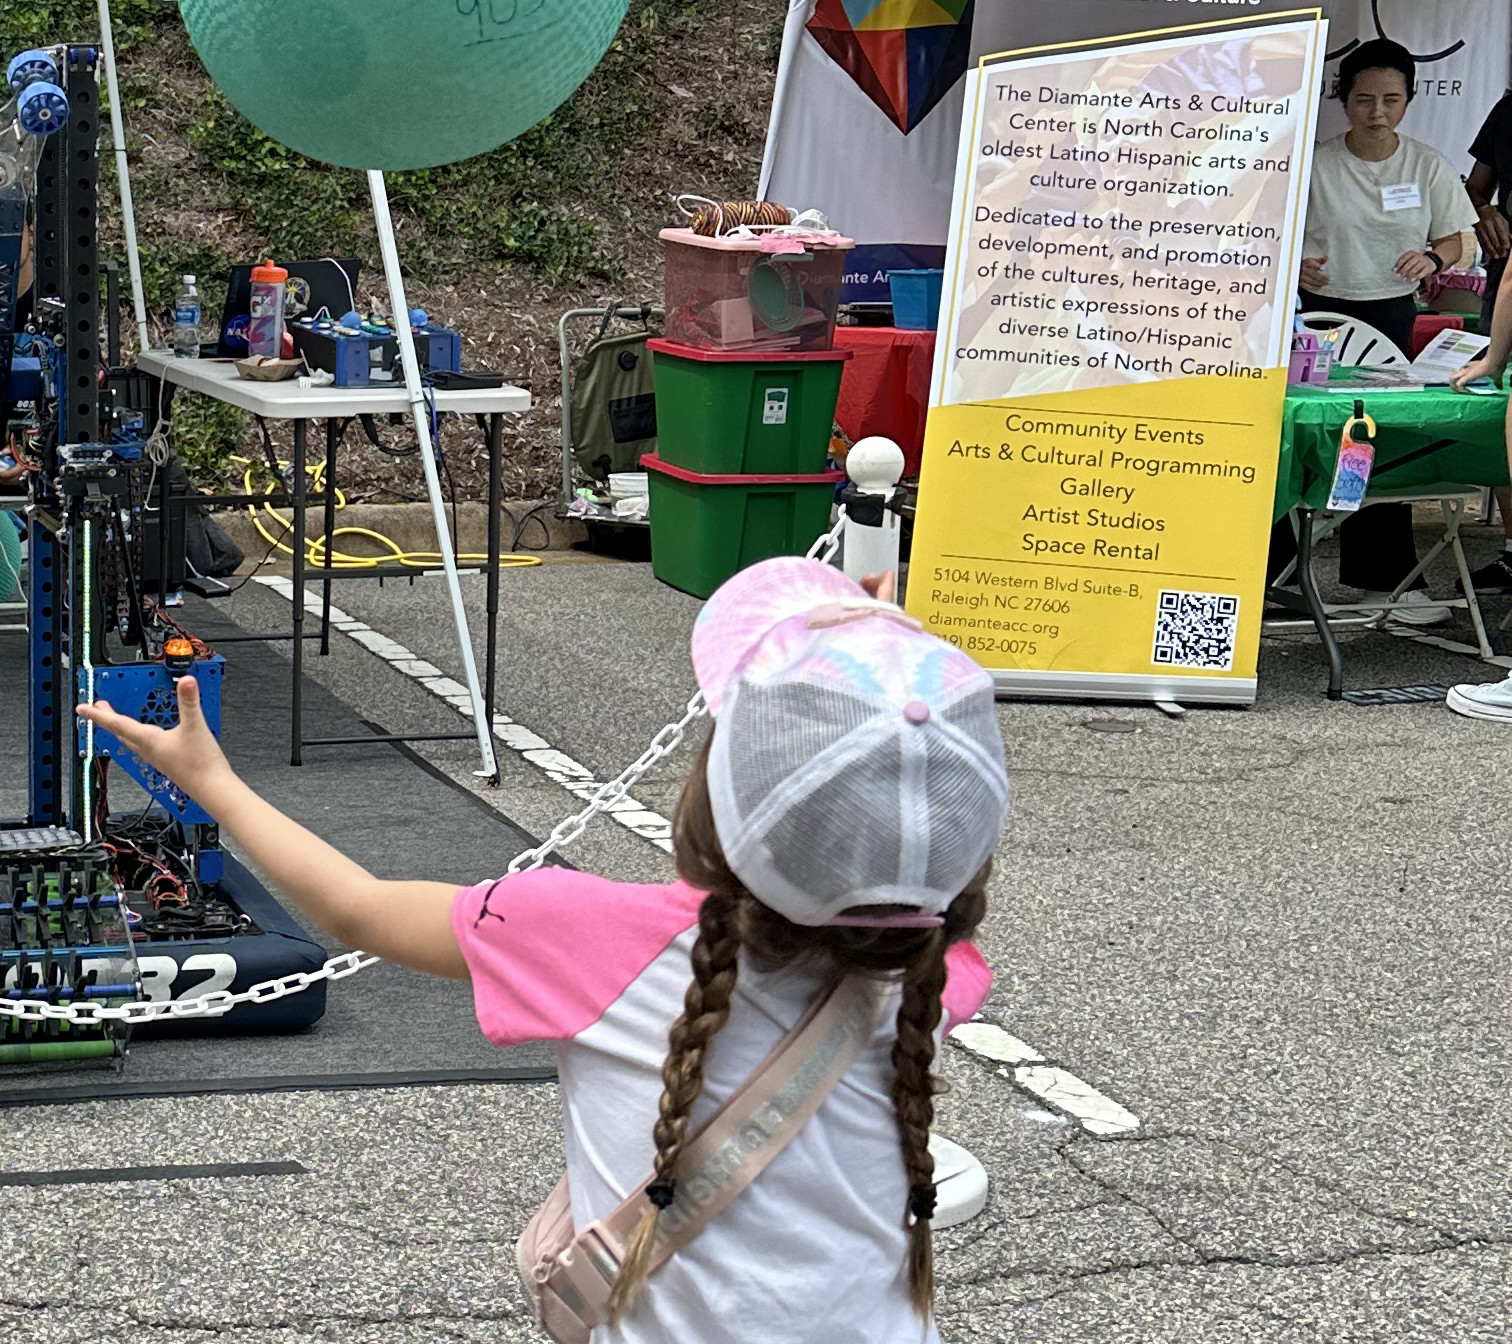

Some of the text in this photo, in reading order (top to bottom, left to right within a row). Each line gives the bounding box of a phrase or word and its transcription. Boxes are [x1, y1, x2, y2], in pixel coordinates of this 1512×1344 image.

[996, 85, 1289, 115] The Diamante Arts & Cultural
[1010, 113, 1268, 142] Center is North Carolina's
[982, 140, 1290, 172] oldest Latino Hispanic arts and
[1030, 171, 1233, 196] culture organization.
[975, 206, 1280, 242] Dedicated to the preservation,
[979, 233, 1271, 267] development, and promotion
[978, 261, 1266, 295] of the cultures, heritage, and
[991, 292, 1246, 321] artistic expressions of the
[999, 318, 1232, 351] diverse Latino/Hispanic
[956, 348, 1268, 380] communities of North Carolina.
[1006, 414, 1204, 445] Community Events
[948, 440, 1255, 483] Arts & Cultural Programming
[1061, 478, 1135, 504] Gallery
[1022, 505, 1165, 531] Artist Studios
[1022, 534, 1159, 560] Space Rental
[934, 568, 970, 583] 5104
[975, 571, 1038, 589] Western
[1044, 577, 1078, 592] Blvd
[932, 590, 1070, 613] Raleigh NC 27606
[929, 610, 1059, 639] diamanteacc.org
[967, 636, 1036, 655] 852-0075
